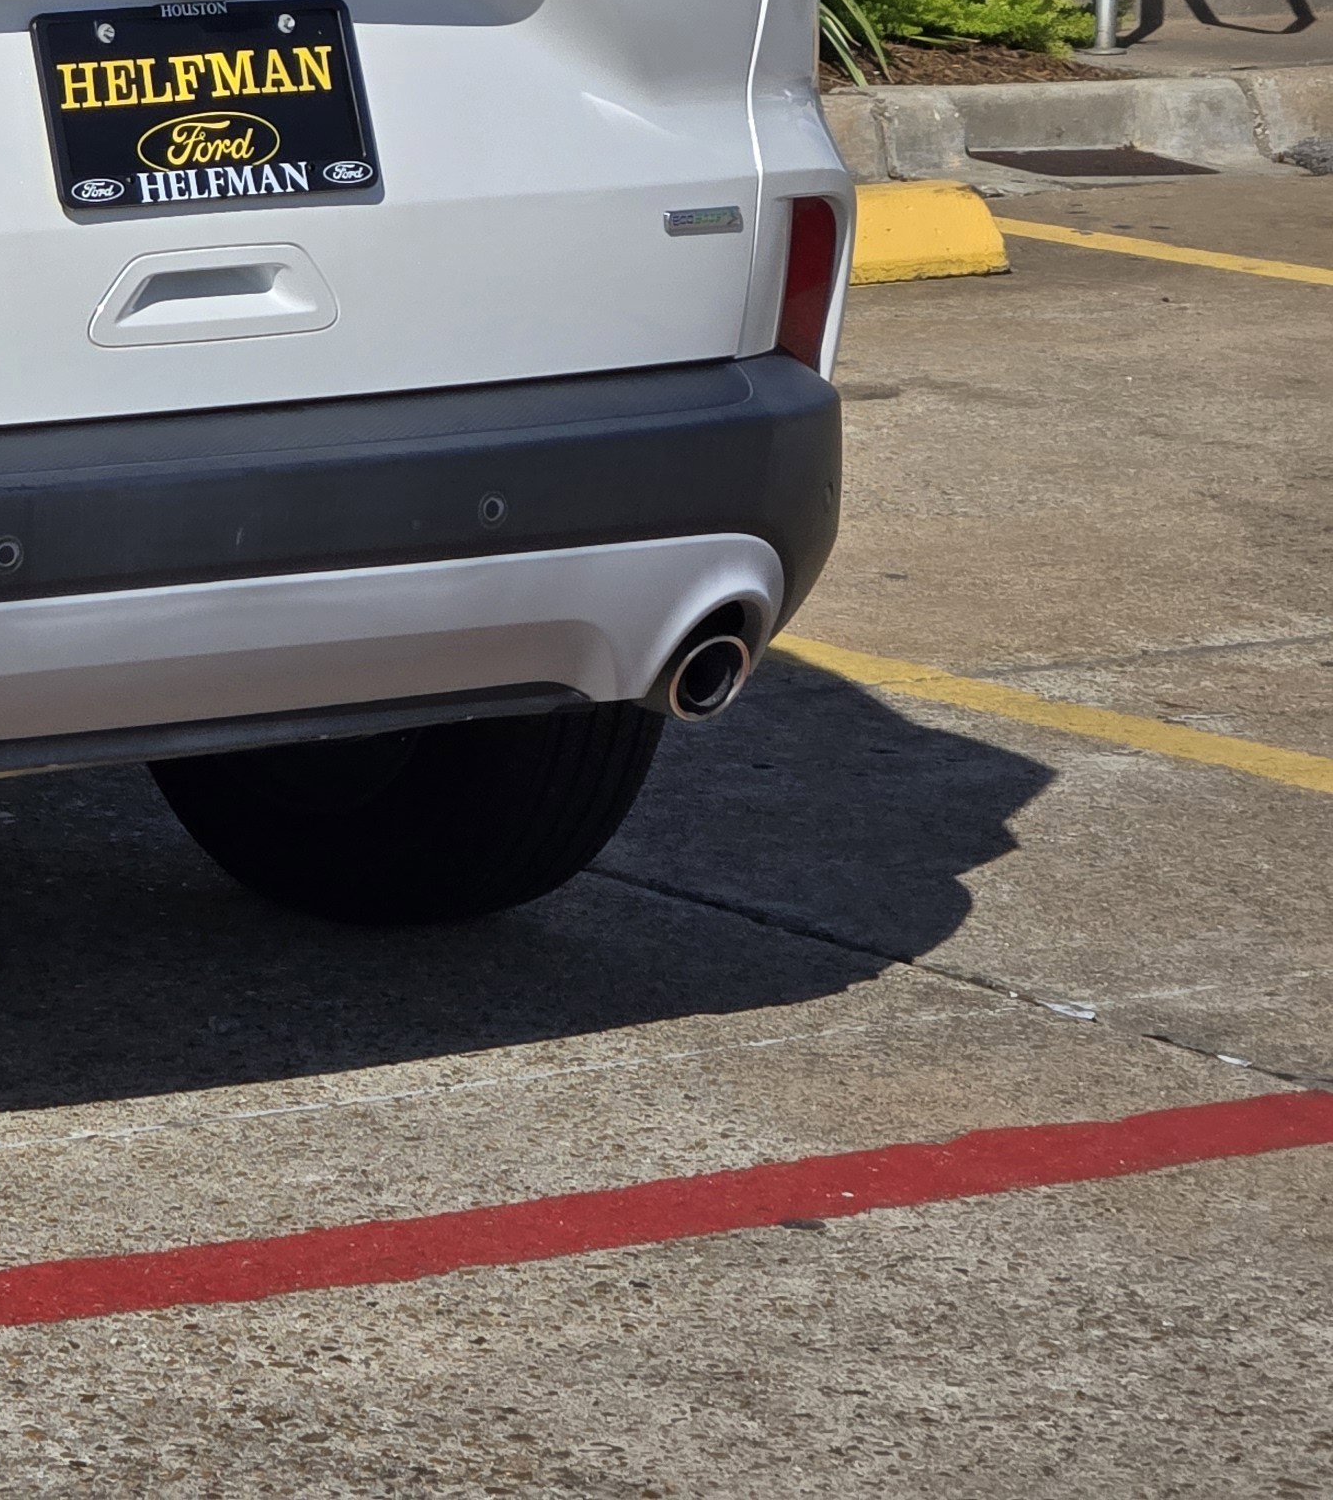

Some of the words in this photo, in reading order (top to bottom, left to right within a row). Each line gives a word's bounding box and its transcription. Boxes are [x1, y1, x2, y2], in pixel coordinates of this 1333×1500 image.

[161, 1, 228, 18] HOUSTON
[56, 45, 332, 110] HELFMAN
[167, 120, 255, 166] Ford
[136, 161, 310, 203] HELFMAN
[332, 164, 364, 180] Ford
[81, 182, 115, 199] Ford
